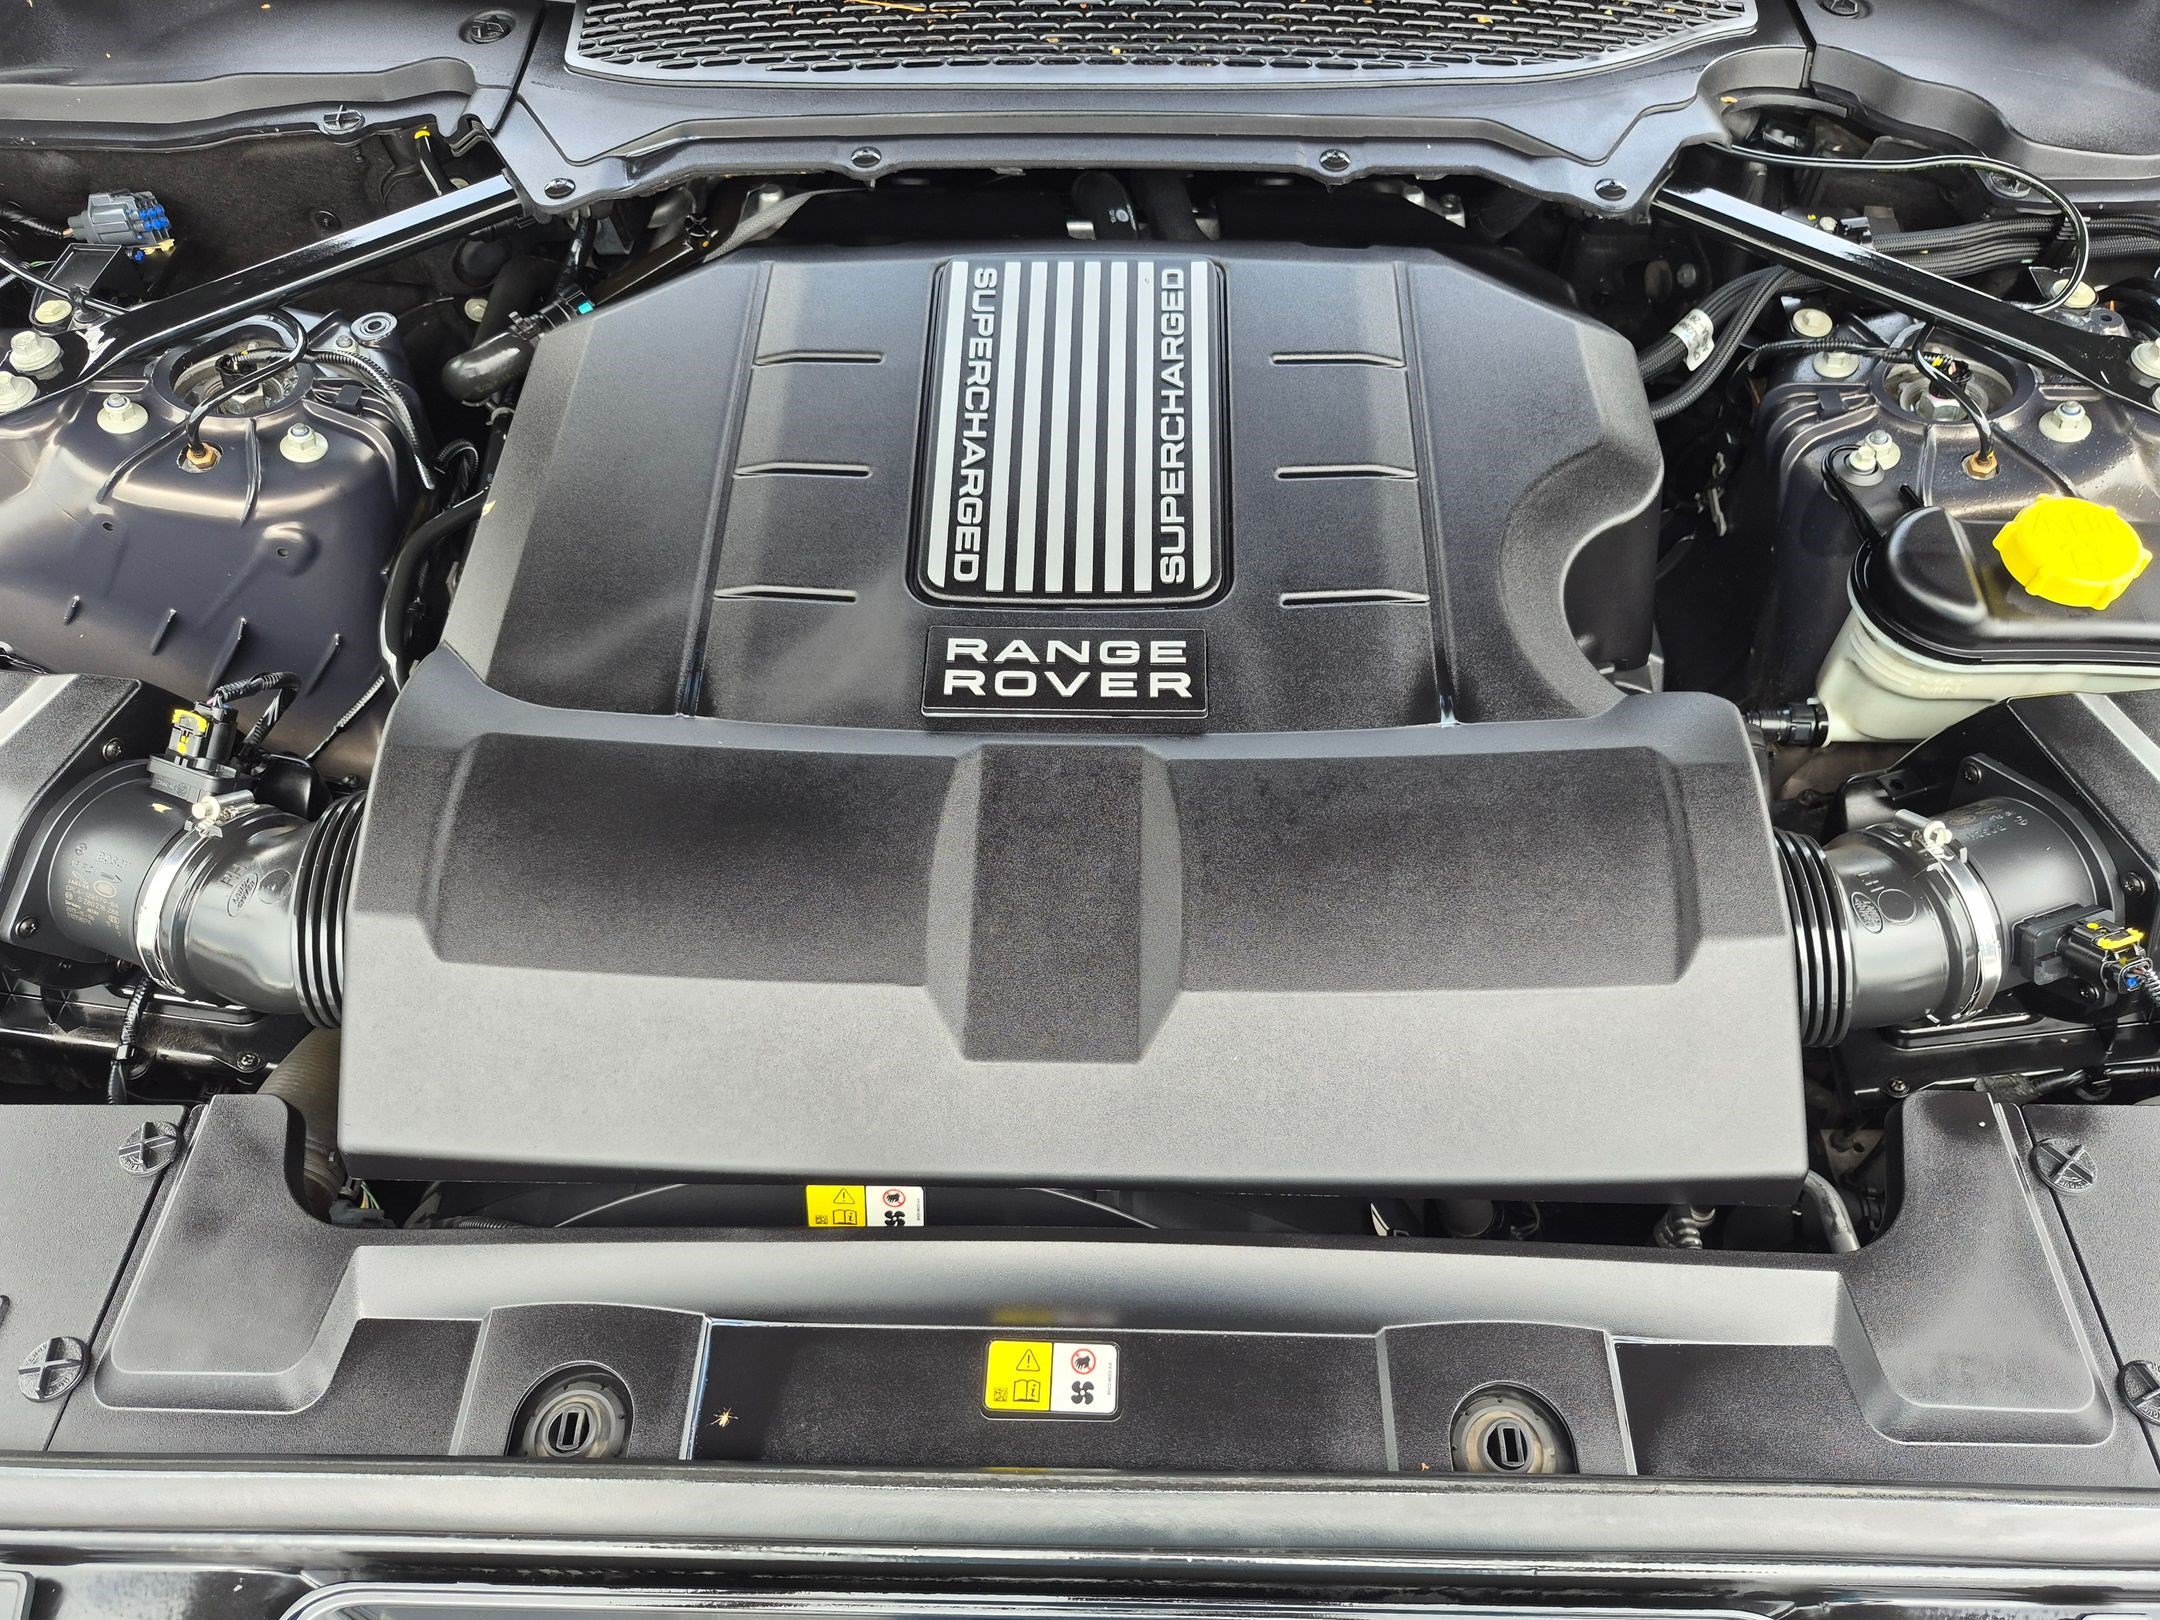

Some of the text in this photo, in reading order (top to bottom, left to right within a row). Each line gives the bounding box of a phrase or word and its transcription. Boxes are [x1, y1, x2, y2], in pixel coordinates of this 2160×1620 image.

[953, 267, 998, 583] SUPERCHARGED
[1159, 268, 1186, 585] SUPERCHARGED
[943, 669, 1193, 698] ROVER
[946, 637, 1187, 665] RANGE
